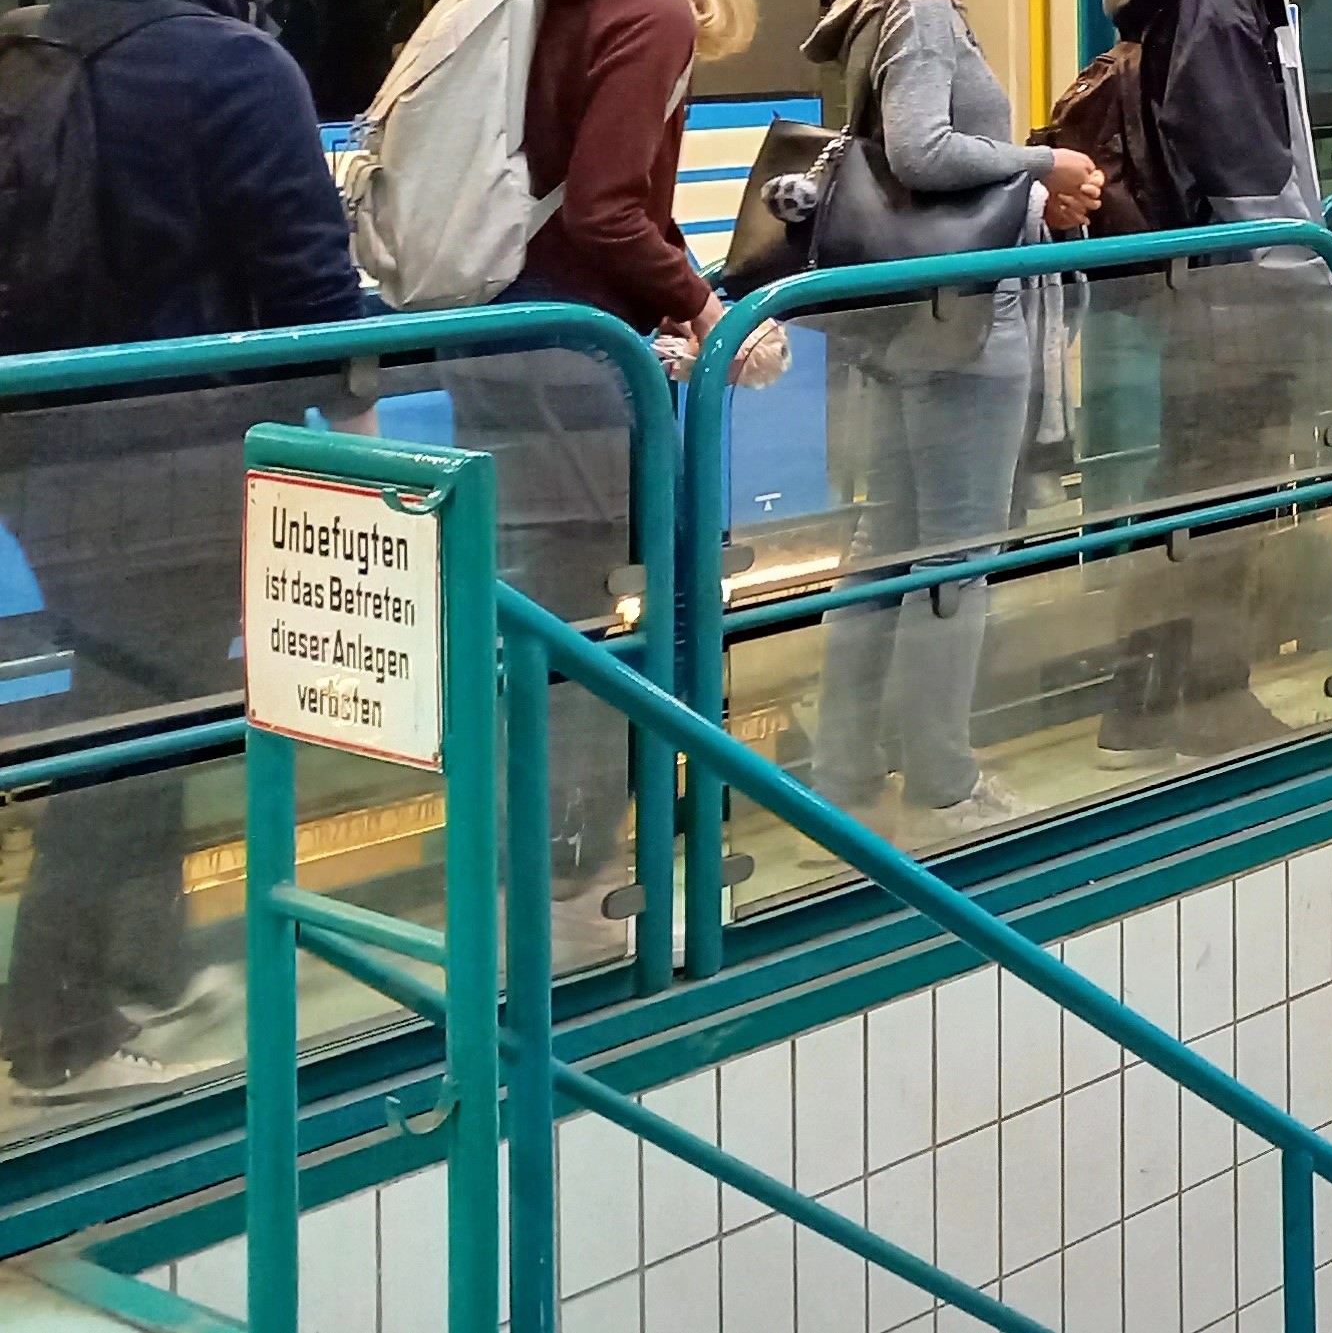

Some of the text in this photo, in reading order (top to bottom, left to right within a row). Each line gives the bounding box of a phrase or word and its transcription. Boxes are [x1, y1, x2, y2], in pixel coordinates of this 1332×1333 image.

[272, 506, 408, 574] Unbefugten
[265, 567, 415, 626] ist das Betreten
[271, 619, 409, 683] dieser Anlagen
